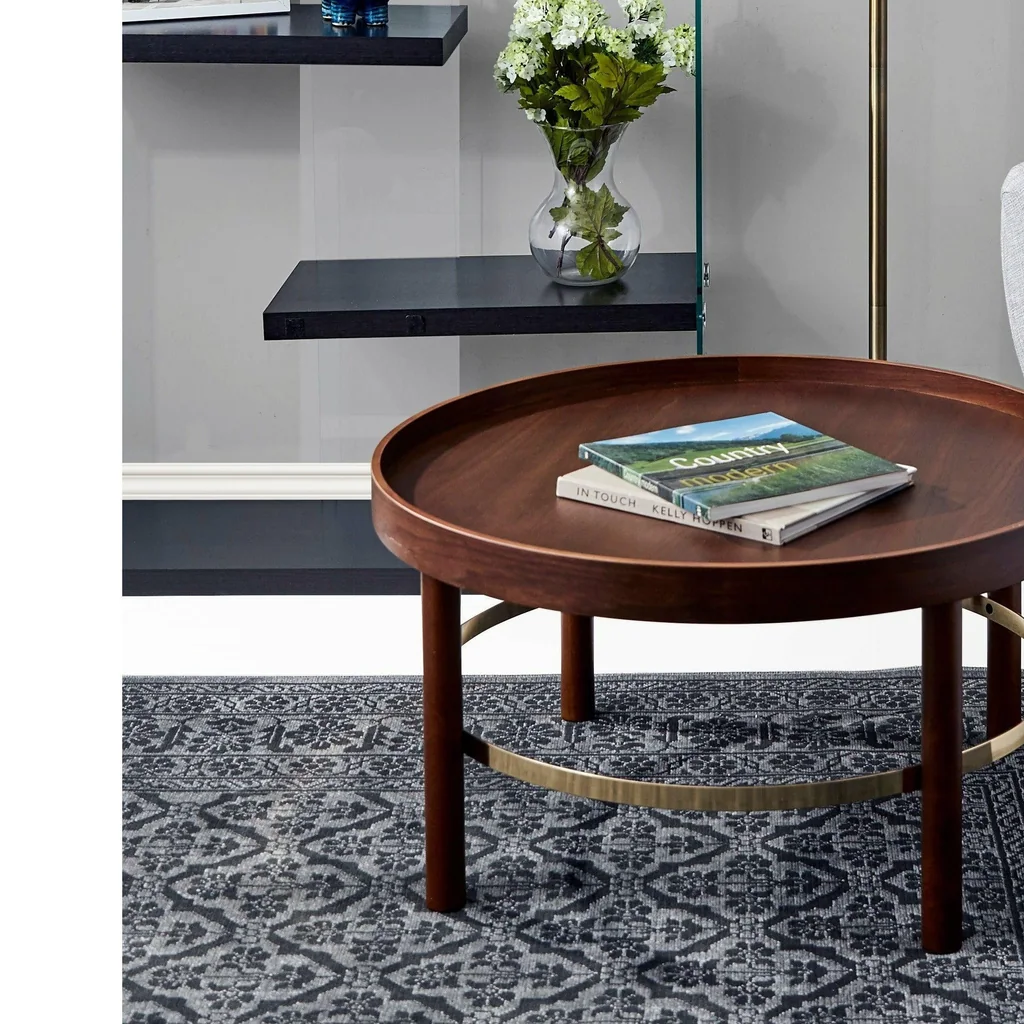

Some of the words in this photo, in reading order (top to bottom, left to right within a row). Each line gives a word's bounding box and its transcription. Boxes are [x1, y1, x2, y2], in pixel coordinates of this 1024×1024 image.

[669, 442, 790, 469] Country
[680, 462, 798, 487] modern
[576, 486, 590, 498] IN
[594, 490, 637, 508] TOUCH
[652, 504, 688, 520] KELLY
